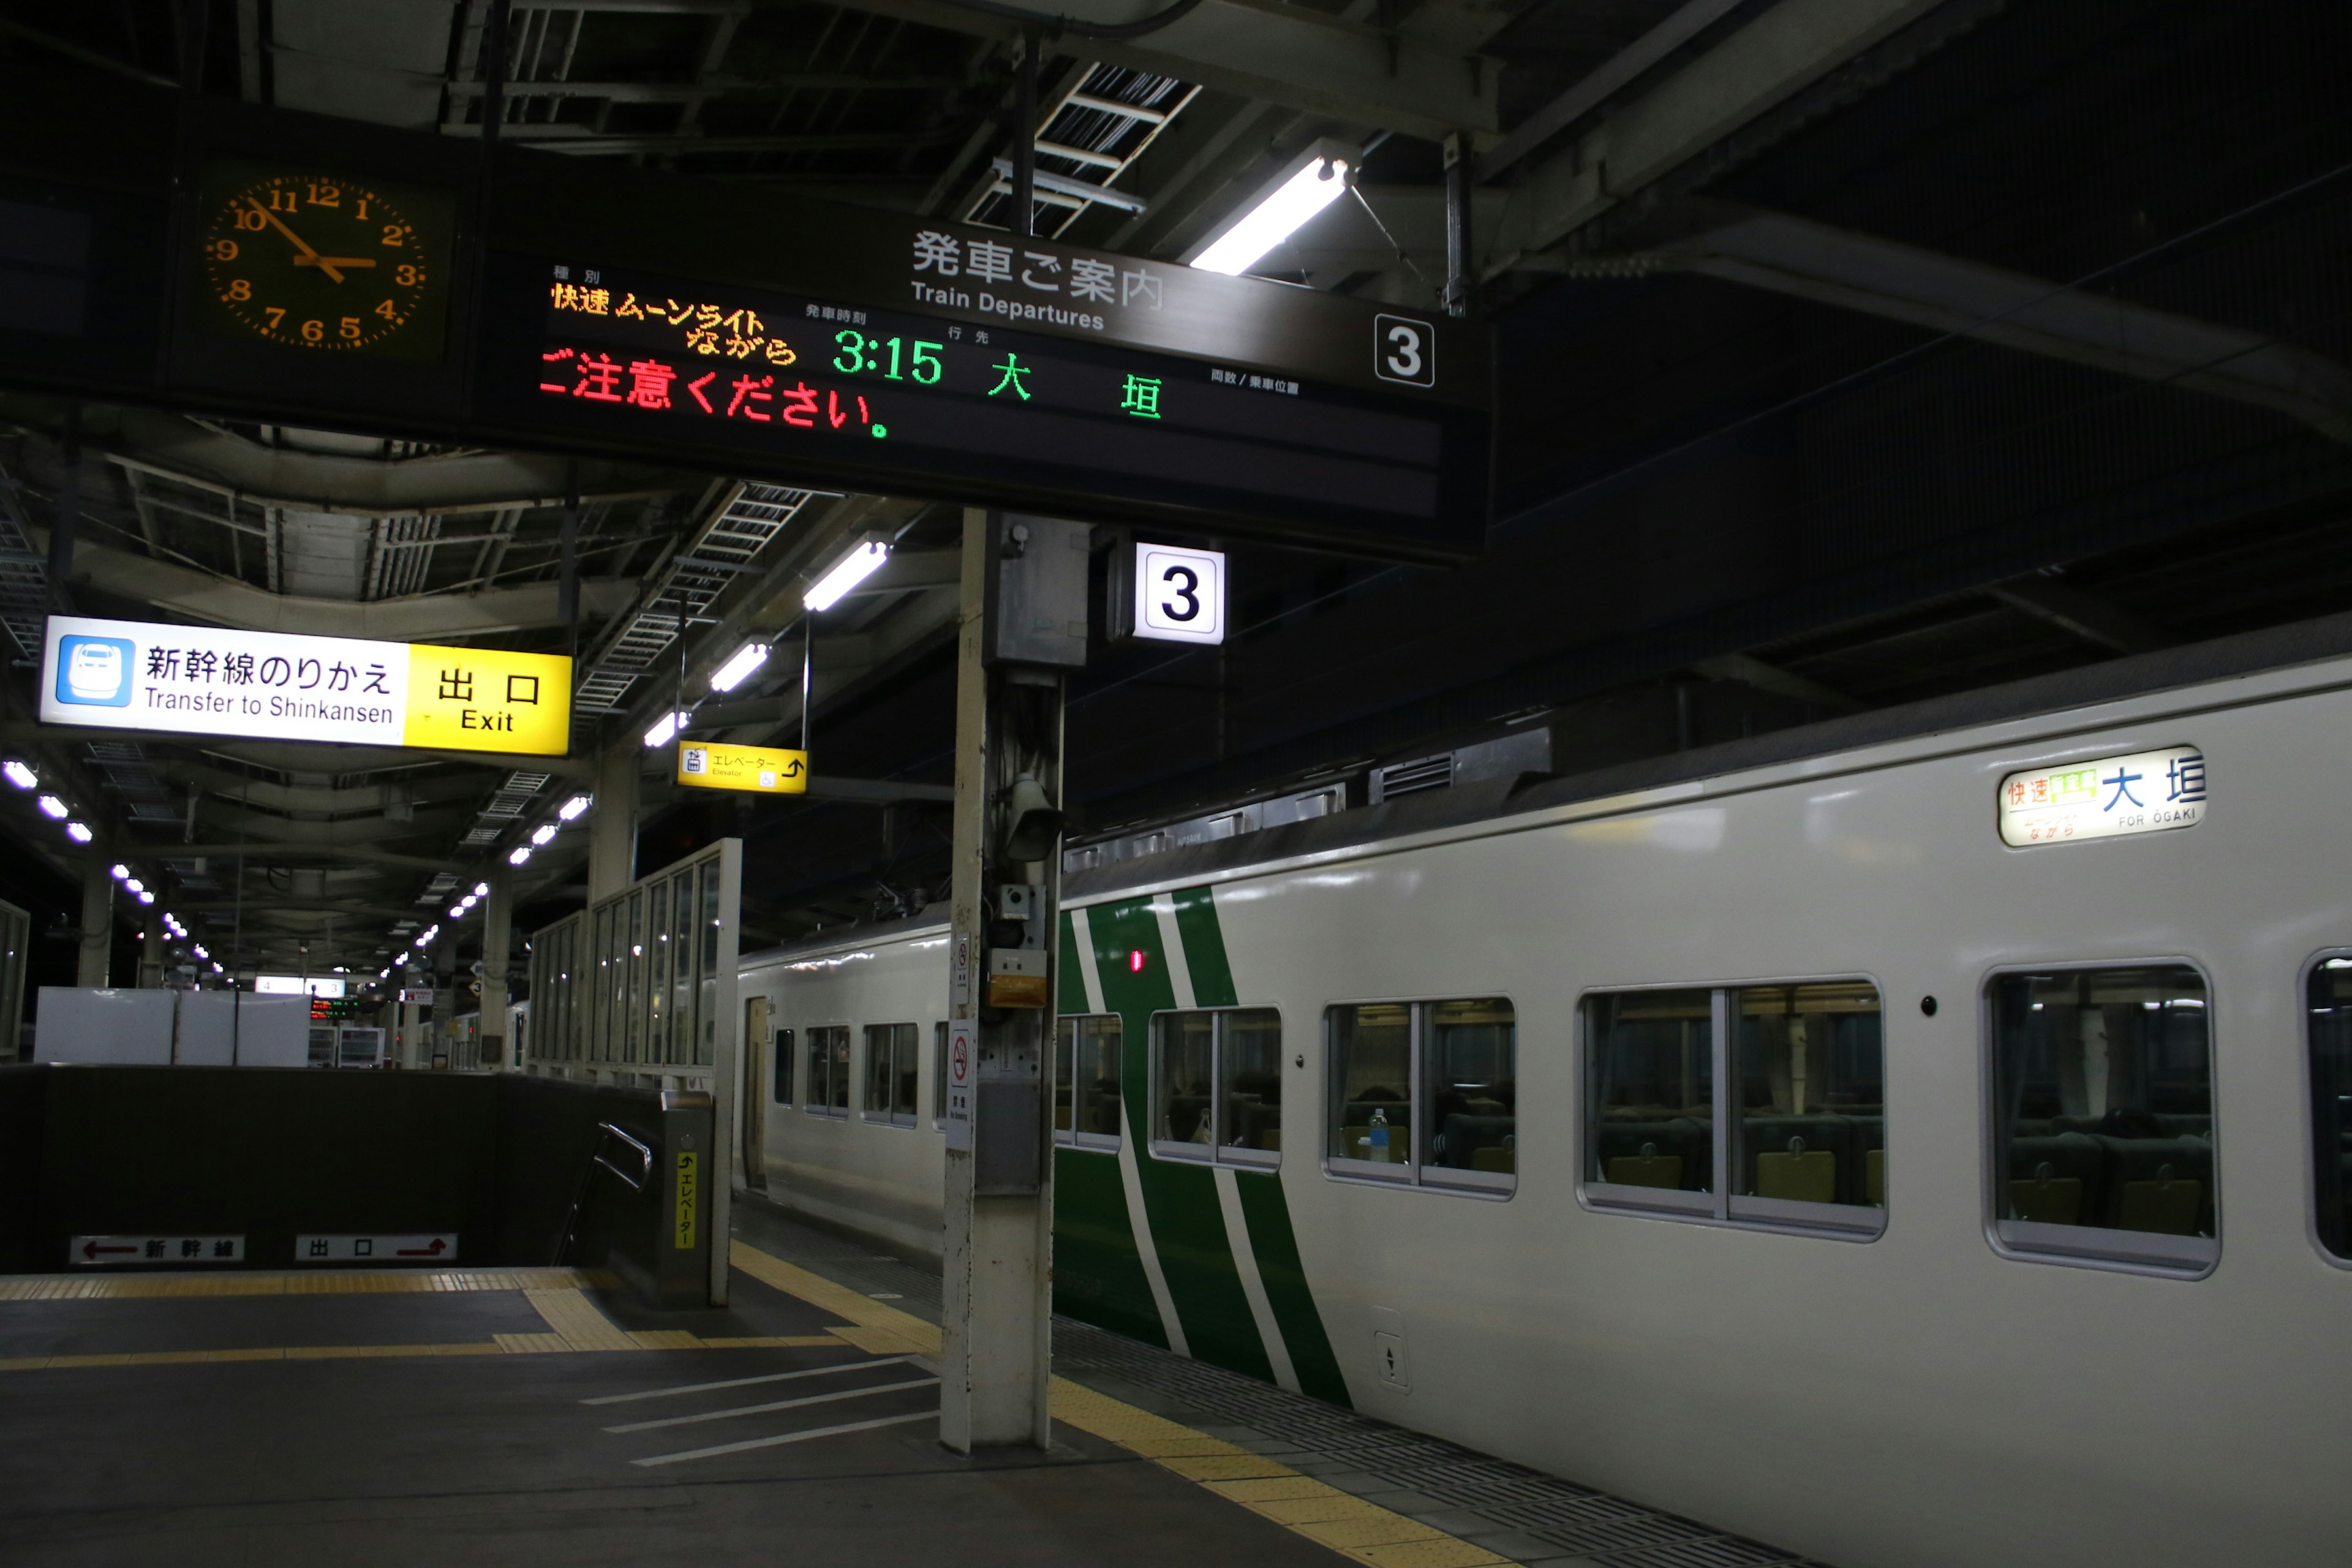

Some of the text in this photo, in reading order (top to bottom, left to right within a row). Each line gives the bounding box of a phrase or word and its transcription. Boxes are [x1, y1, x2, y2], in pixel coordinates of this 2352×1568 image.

[270, 190, 298, 213] 11
[307, 184, 341, 208] 12
[234, 208, 267, 232] 10
[355, 199, 369, 221] 1
[382, 225, 404, 246] 2
[216, 239, 239, 261] 9
[395, 265, 417, 286] 3
[913, 230, 1164, 312] 発車ご案内
[228, 279, 252, 301] 8
[375, 299, 397, 320] 4
[551, 282, 764, 336] 快速 ムーンライト
[805, 303, 867, 326] 発車時刻
[911, 281, 1105, 331] Train Departures
[265, 307, 287, 329] 7
[339, 317, 361, 339] 5
[301, 320, 324, 341] 6
[687, 327, 797, 366] ながら
[833, 329, 944, 385] 3:15
[1387, 326, 1422, 377] 3
[1162, 565, 1200, 622] 3
[146, 645, 392, 696] 新幹線のりかえ
[438, 668, 540, 706] 出口
[145, 687, 393, 724] Transfer to Shinkansen
[461, 710, 515, 733] Exit
[712, 755, 775, 769] エレベーター
[712, 768, 742, 777] Elevator
[2007, 778, 2049, 806] 快速
[2030, 823, 2075, 840] ながら
[2119, 816, 2144, 827] FOR
[263, 981, 270, 990] 4
[331, 984, 338, 993] 3
[680, 1174, 693, 1245] エレベーター
[145, 1239, 234, 1259] 新幹線
[309, 1238, 373, 1257] 出口
